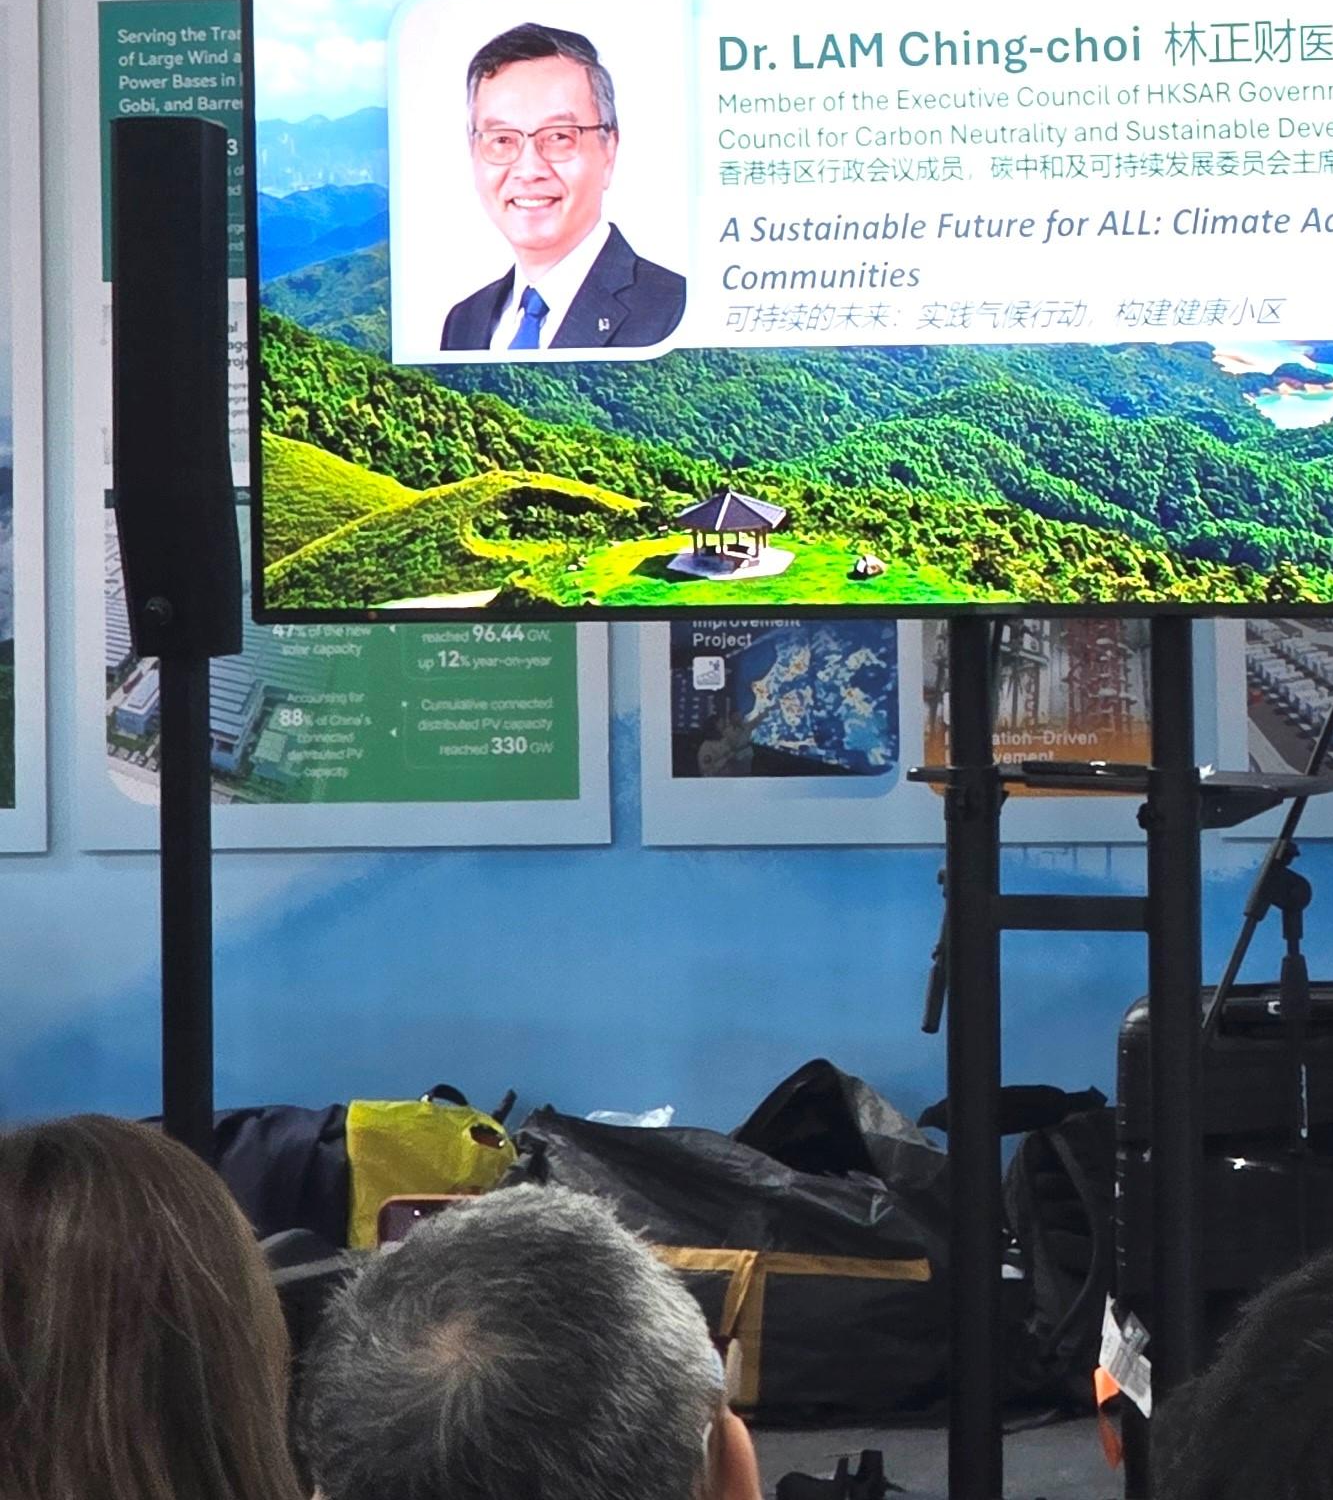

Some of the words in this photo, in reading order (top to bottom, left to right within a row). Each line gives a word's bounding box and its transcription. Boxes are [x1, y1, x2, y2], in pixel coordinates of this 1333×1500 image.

[117, 28, 177, 46] Serving
[180, 26, 207, 42] the
[118, 52, 135, 66] of
[138, 52, 184, 70] Large
[187, 49, 228, 65] Wind
[719, 35, 777, 71] Dr.
[793, 32, 884, 69] LAM
[899, 25, 1142, 74] Ching-choi
[119, 75, 168, 90] Power
[172, 73, 217, 88] Bases
[221, 73, 236, 87] in
[119, 97, 160, 114] Gobi,
[163, 96, 194, 112] and
[719, 92, 816, 114] Member
[823, 91, 846, 111] of
[852, 91, 889, 111] the
[897, 87, 1009, 110] Executive
[1017, 84, 1110, 107] Council
[1117, 84, 1140, 105] of
[1147, 82, 1231, 104] HKSAR
[719, 127, 810, 150] Council
[817, 127, 849, 148] for
[855, 126, 943, 147] Carbon
[951, 122, 1067, 148] Neutrality
[1074, 121, 1118, 143] and
[1126, 118, 1270, 142] Sustainable
[720, 217, 740, 242] A
[750, 212, 927, 242] Sustainable
[937, 213, 1035, 239] Future
[1042, 208, 1089, 244] for
[1097, 210, 1162, 236] ALL:
[1173, 207, 1290, 235] Climate
[722, 261, 921, 290] Communities
[472, 624, 525, 642] 96.44
[692, 632, 752, 650] Project
[438, 650, 471, 667] 12%
[491, 736, 528, 755] 330
